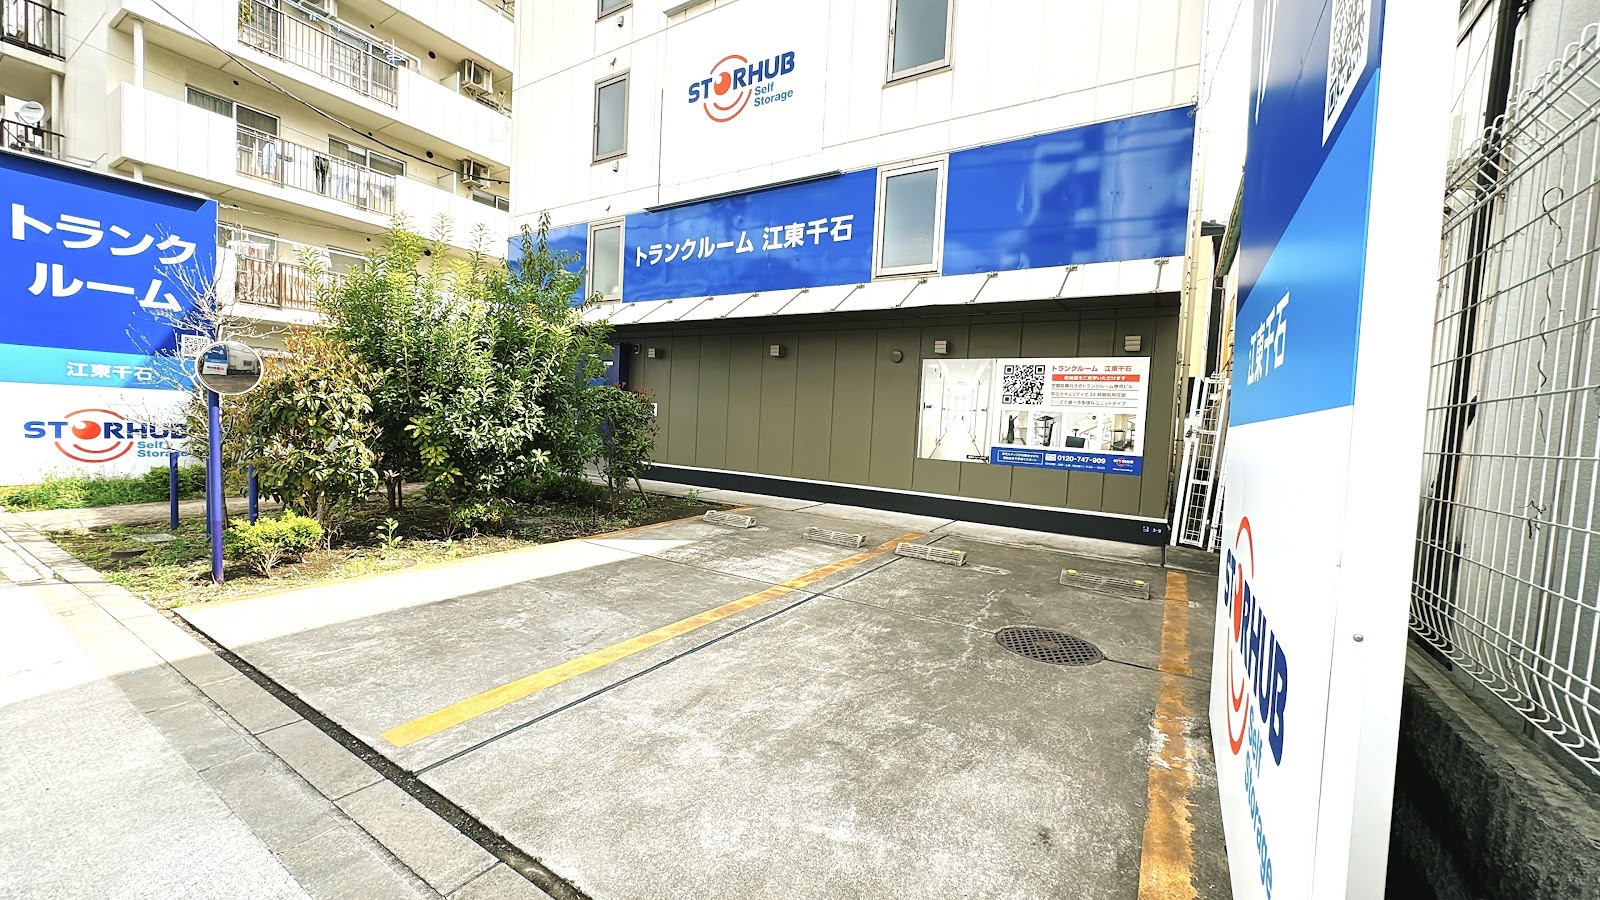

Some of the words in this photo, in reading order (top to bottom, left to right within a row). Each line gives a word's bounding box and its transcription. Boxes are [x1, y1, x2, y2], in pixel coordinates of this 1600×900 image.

[688, 51, 795, 104] STORHUB
[754, 89, 793, 107] Storage
[755, 81, 774, 97] Self
[12, 203, 196, 265] トランク
[636, 231, 754, 268] トランクルーム
[762, 214, 854, 251] 江東千石
[28, 262, 182, 312] ルーム
[1247, 291, 1290, 386] 江東千石
[66, 361, 153, 381] 江東千石
[137, 441, 163, 449] Self
[1057, 454, 1106, 464] 0120-747-909
[1224, 548, 1288, 766] STORHUB
[1248, 705, 1263, 779] Self
[1244, 750, 1273, 899] Storage
